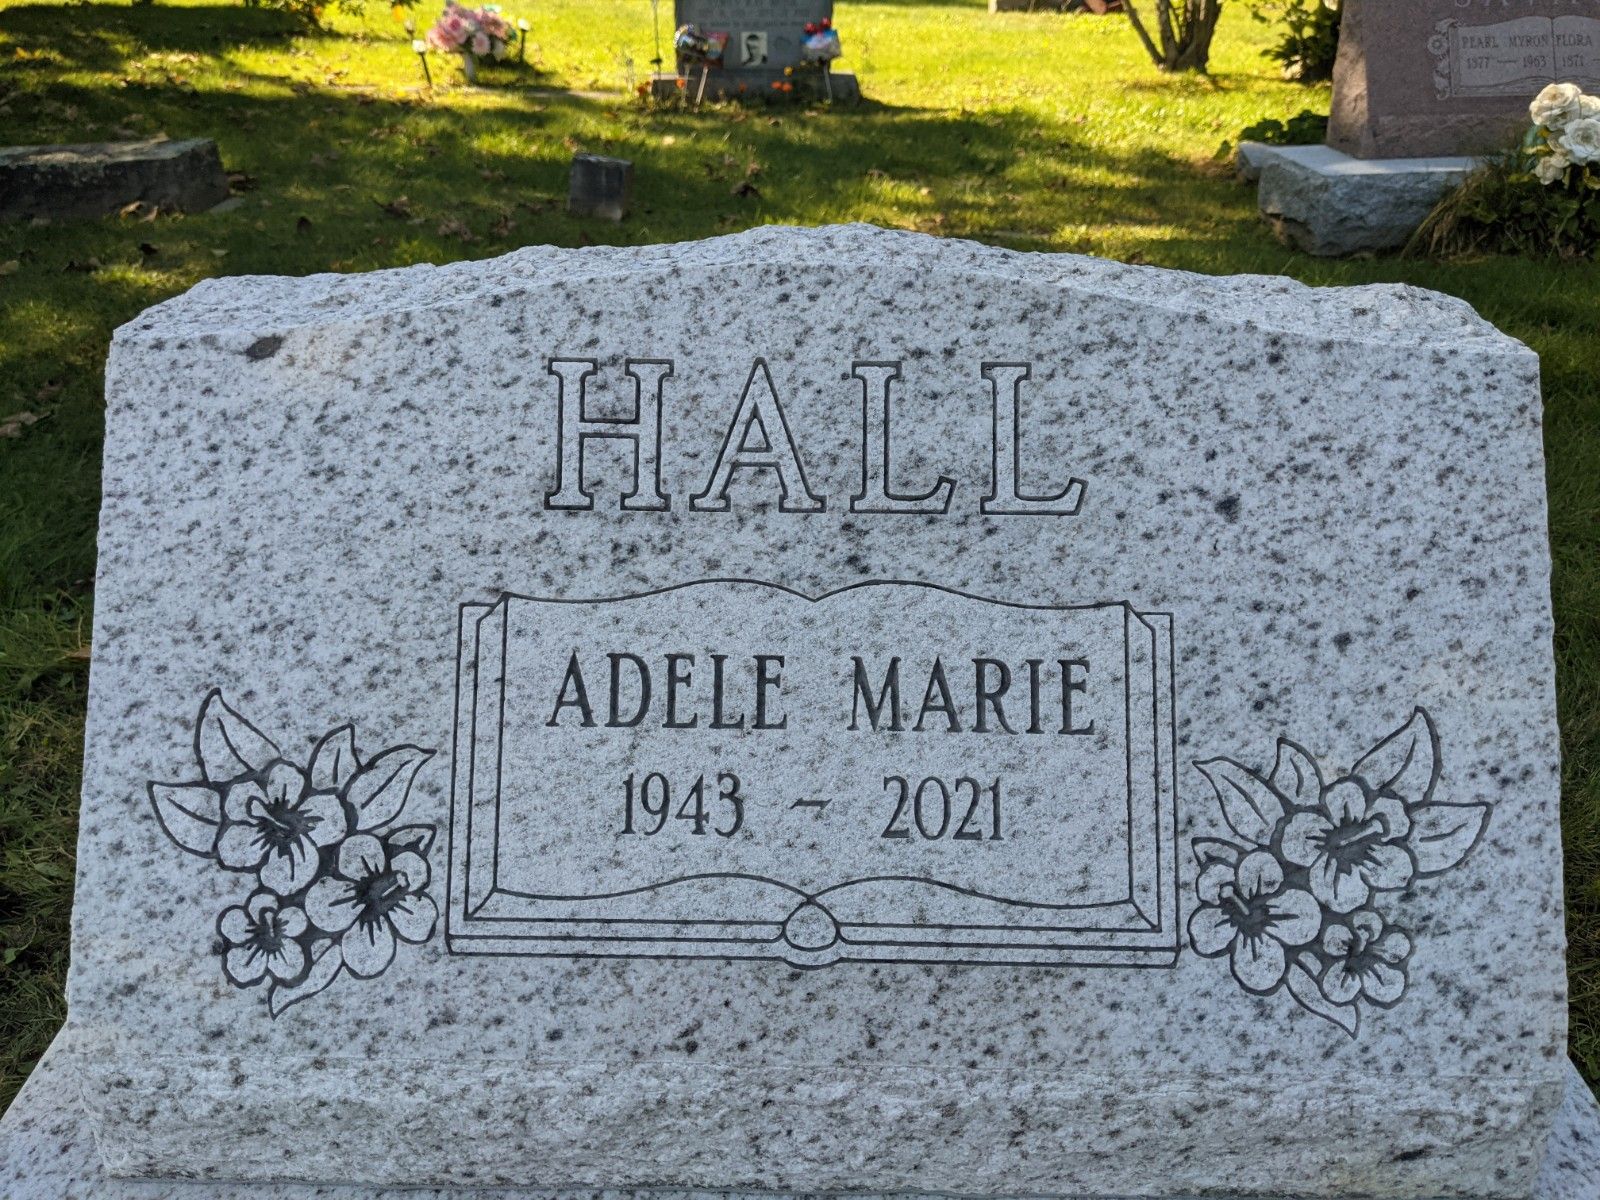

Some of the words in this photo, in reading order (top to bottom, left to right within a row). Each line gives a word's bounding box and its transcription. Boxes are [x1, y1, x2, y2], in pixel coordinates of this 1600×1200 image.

[1462, 36, 1499, 49] PEARL
[1509, 34, 1549, 48] MYRON
[1555, 33, 1593, 47] FLORA
[543, 356, 1089, 516] HALL
[545, 649, 788, 730] ADELE
[846, 655, 1096, 736] MARIE
[620, 772, 746, 838] 1943
[881, 775, 1005, 841] 2021
